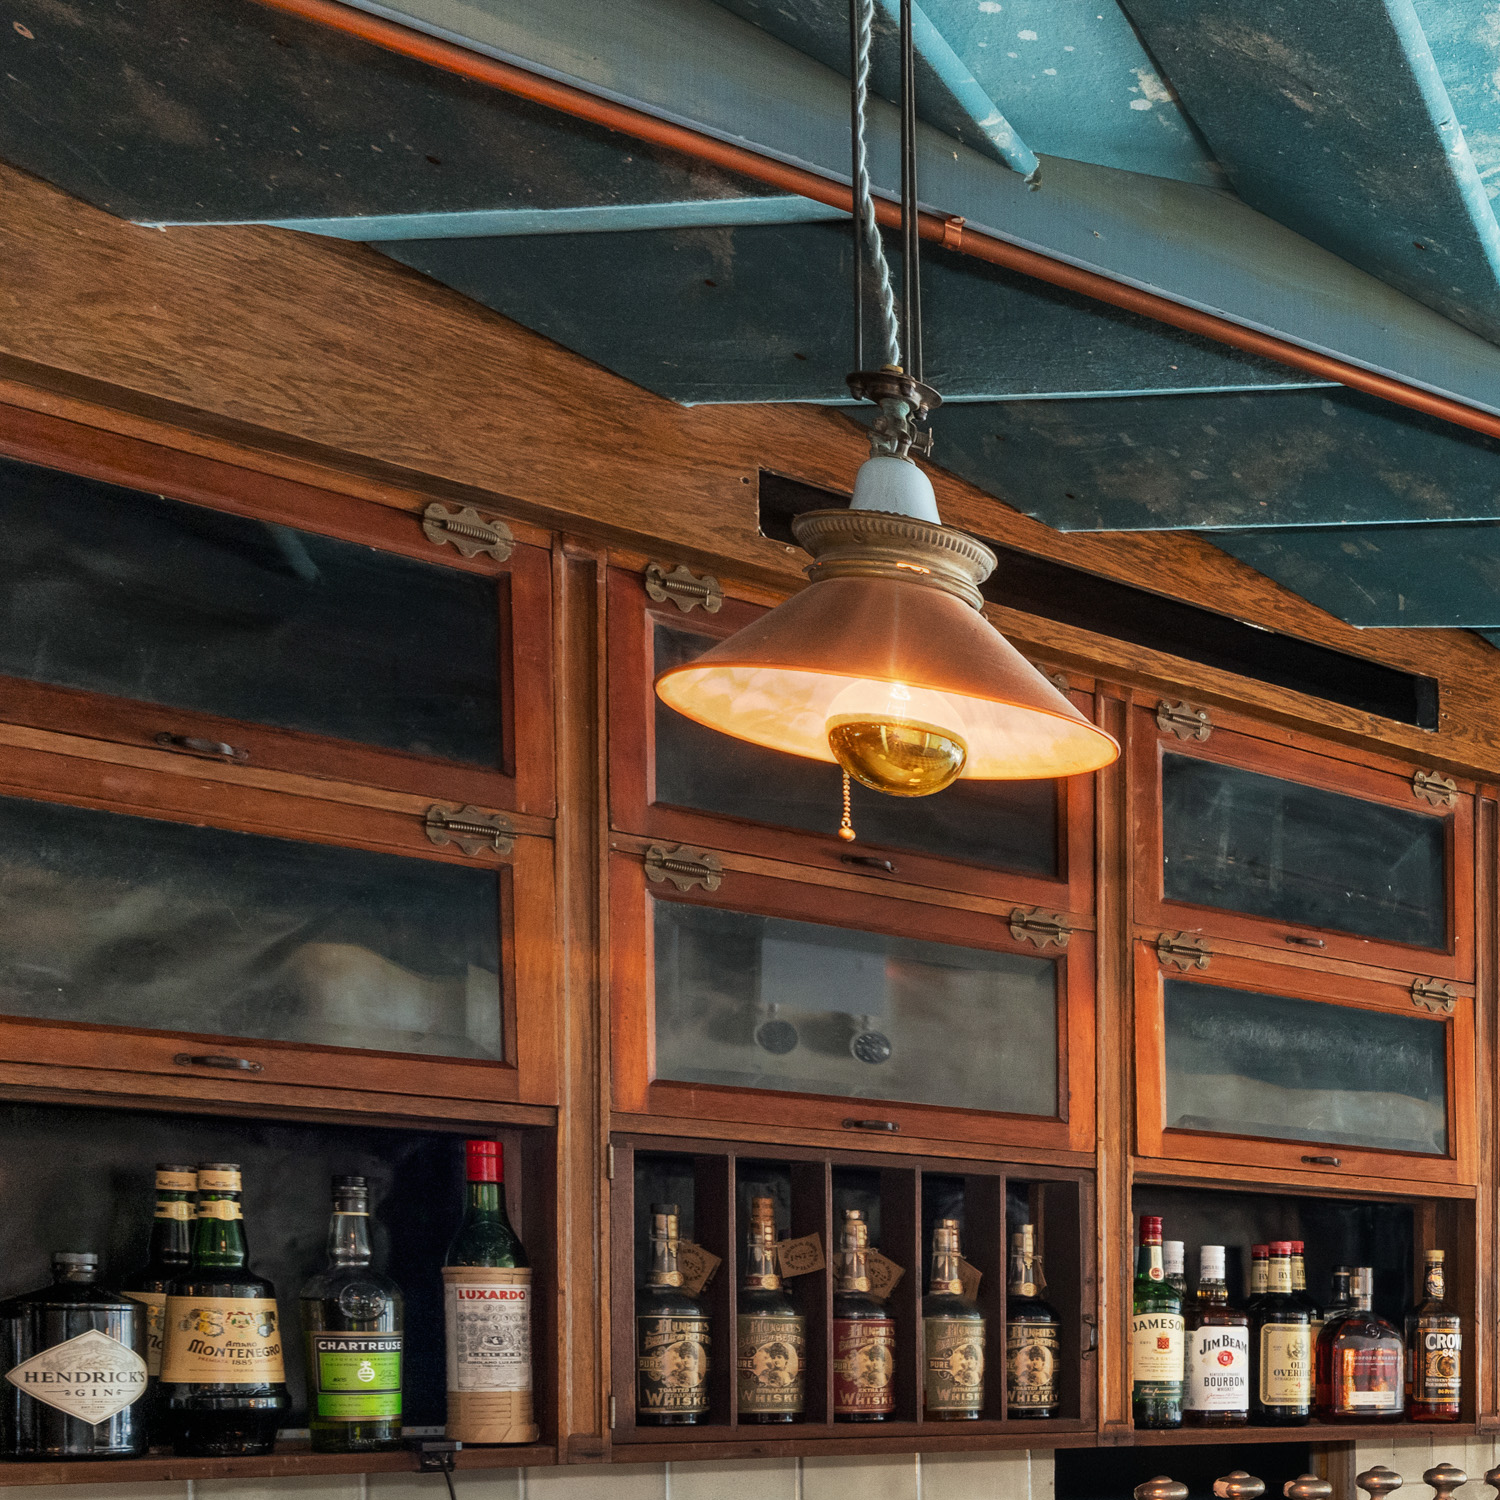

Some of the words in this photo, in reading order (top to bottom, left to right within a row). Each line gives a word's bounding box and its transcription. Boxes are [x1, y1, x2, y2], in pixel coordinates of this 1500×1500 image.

[458, 1289, 526, 1300] LUXARDO
[318, 1341, 402, 1351] CHARTREUSE
[1199, 1337, 1220, 1356] JIM
[1222, 1334, 1248, 1355] BEAM
[1425, 1333, 1462, 1351] CROW
[1442, 1348, 1454, 1357] 86
[929, 1360, 950, 1369] PURE
[1290, 1361, 1306, 1370] OLD
[24, 1370, 146, 1384] HENDRICK'S
[1203, 1376, 1245, 1387] BOURBON
[75, 1388, 115, 1397] GIN
[840, 1389, 895, 1405] WHISKE
